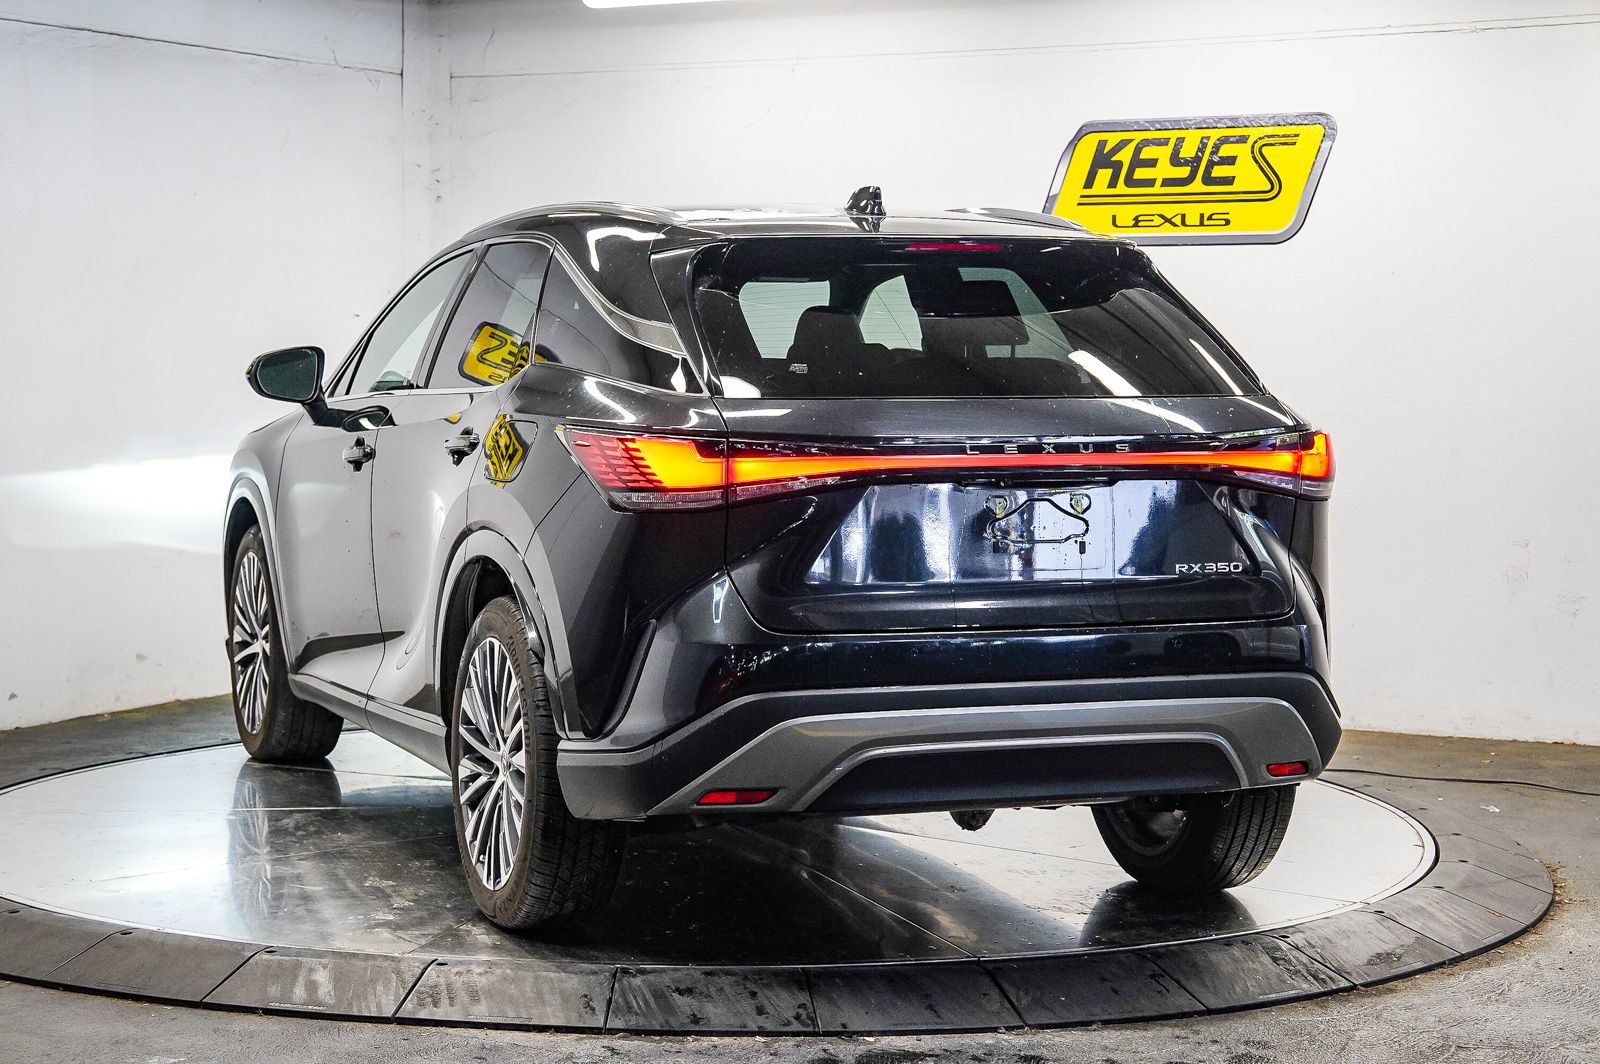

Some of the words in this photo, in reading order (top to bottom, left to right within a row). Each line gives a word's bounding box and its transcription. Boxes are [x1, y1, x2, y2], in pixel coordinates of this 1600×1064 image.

[1083, 133, 1300, 193] KEYES
[1111, 211, 1231, 228] LEXUS
[965, 443, 1131, 455] LEXUS
